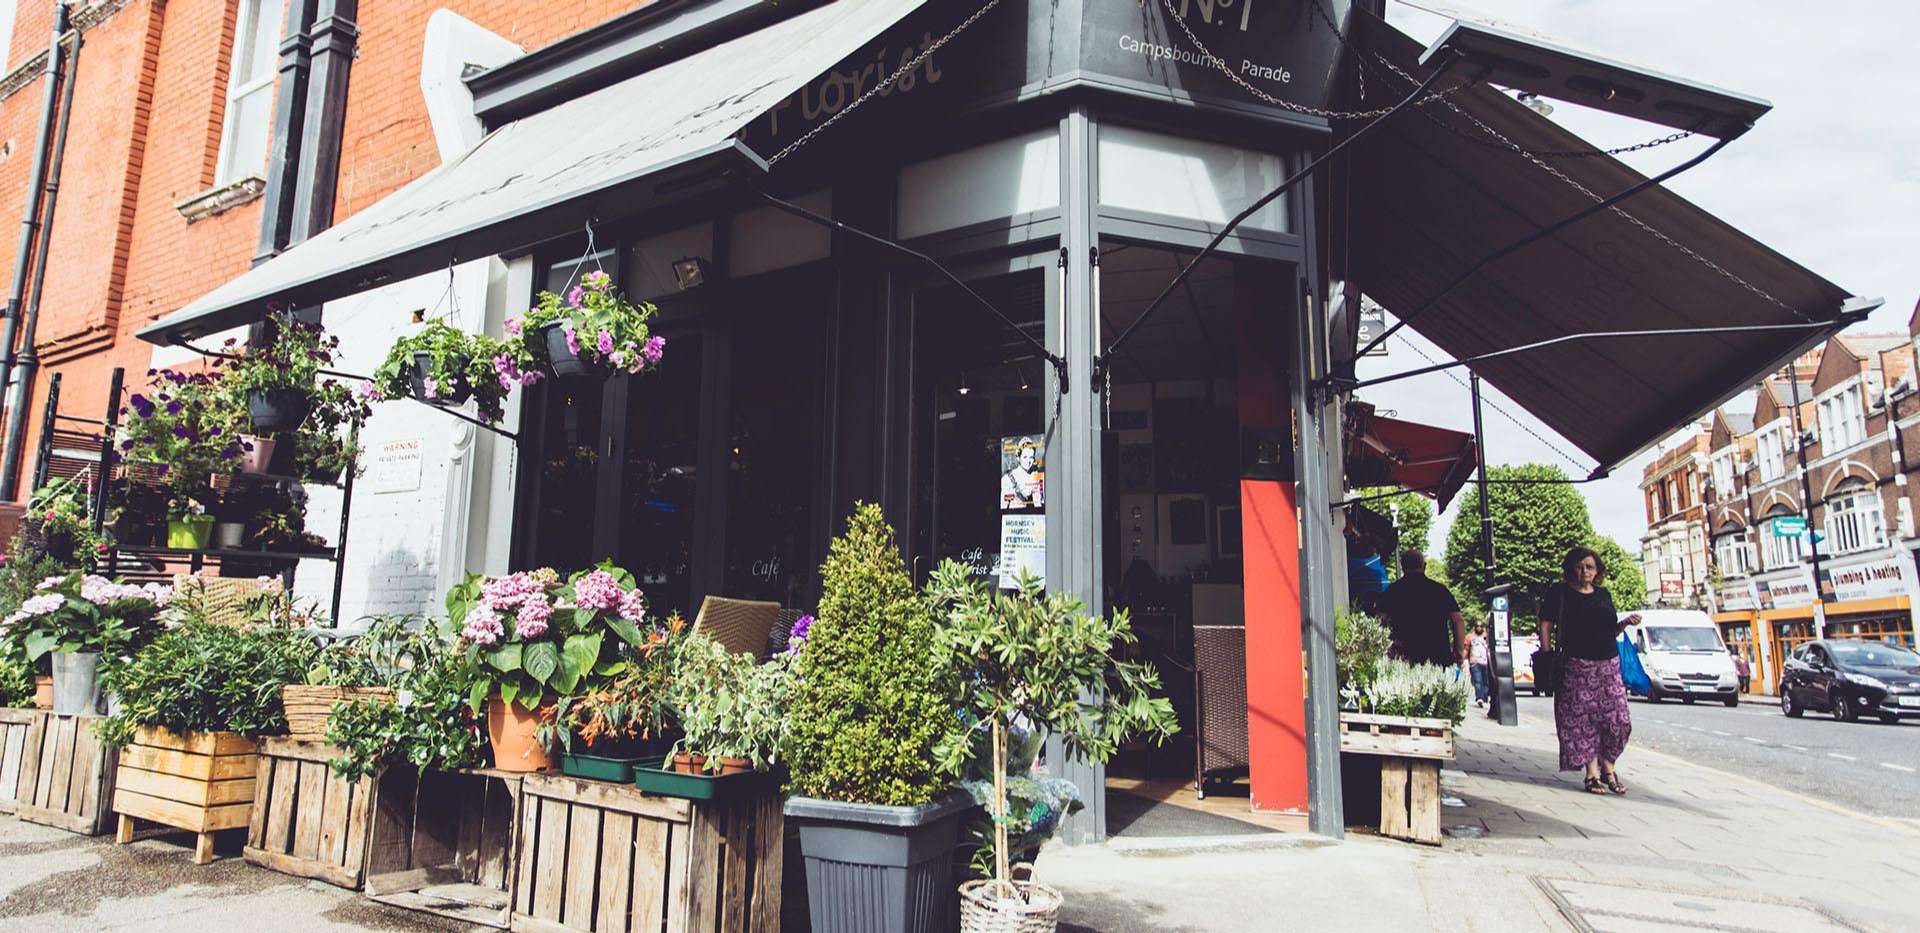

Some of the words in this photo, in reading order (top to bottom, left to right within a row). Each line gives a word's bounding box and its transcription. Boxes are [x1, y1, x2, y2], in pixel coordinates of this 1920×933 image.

[1119, 35, 1225, 71] Campsbourne
[1241, 59, 1291, 83] Parade
[383, 441, 419, 451] WARNING
[961, 547, 984, 564] Café
[752, 556, 781, 582] Café
[1834, 570, 1865, 586] plumbing
[1872, 563, 1902, 581] heating
